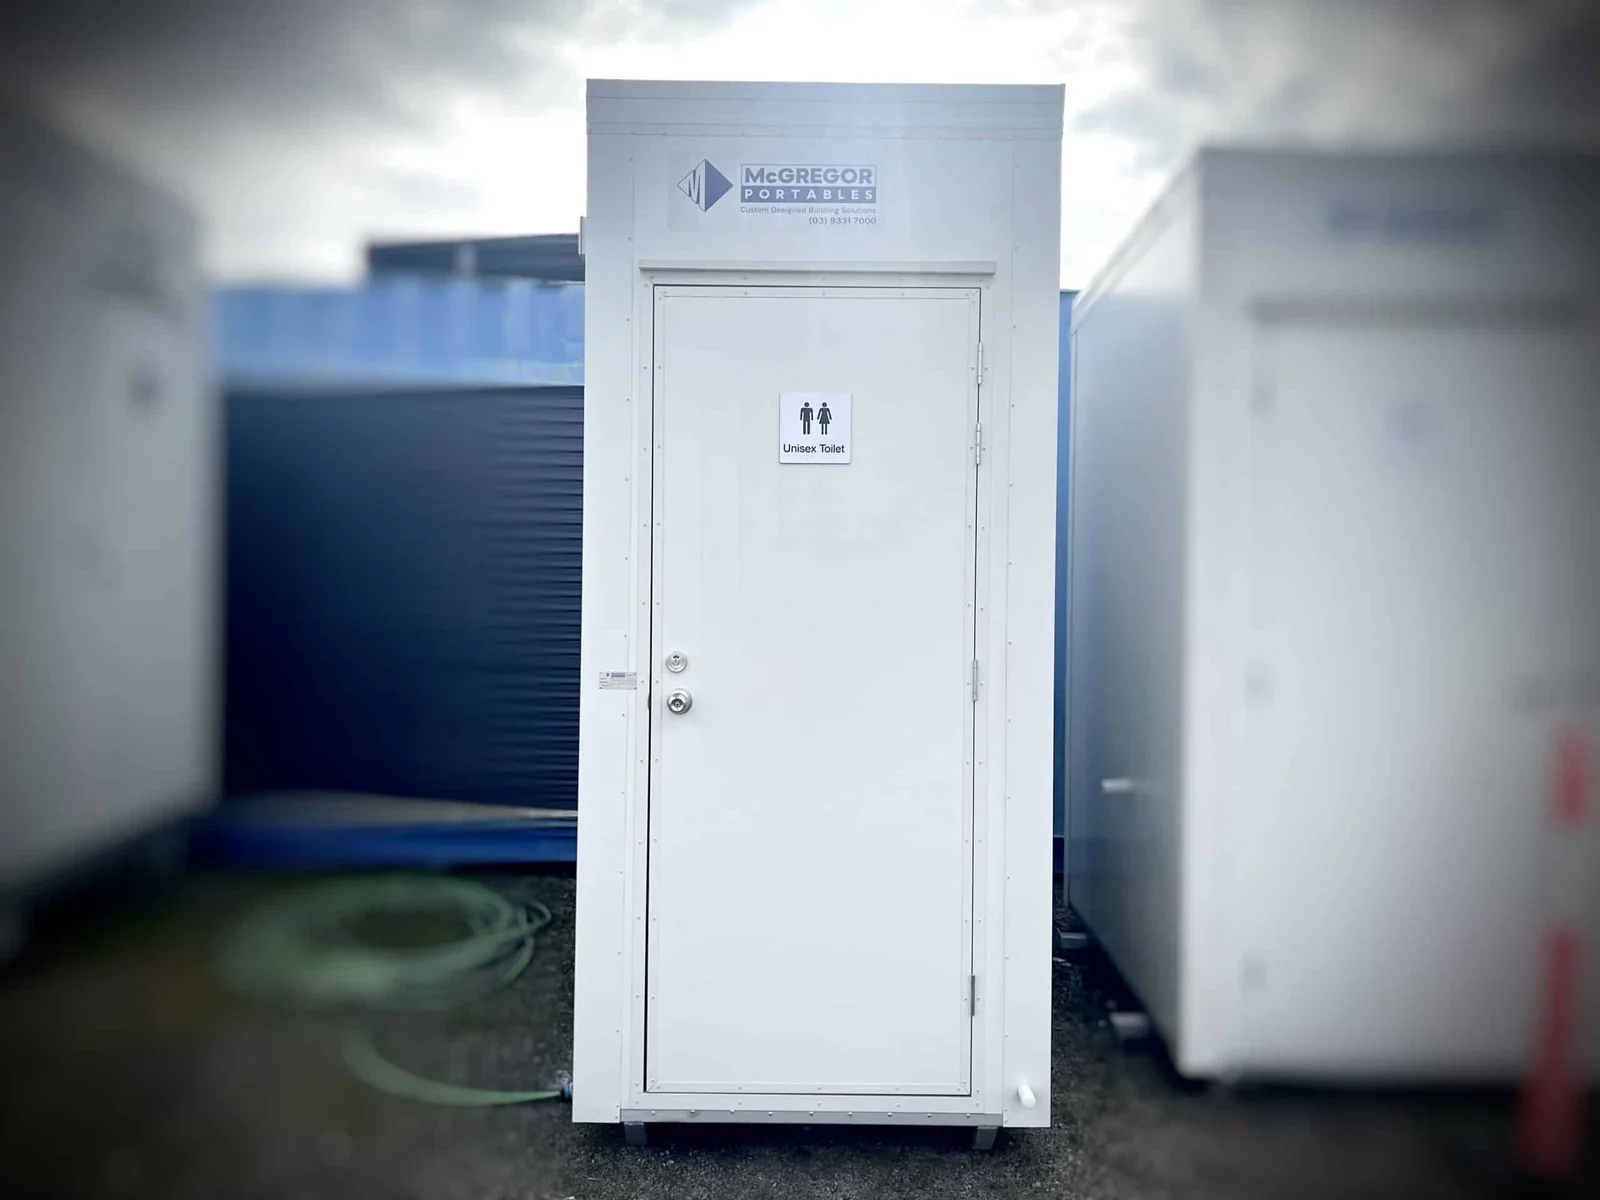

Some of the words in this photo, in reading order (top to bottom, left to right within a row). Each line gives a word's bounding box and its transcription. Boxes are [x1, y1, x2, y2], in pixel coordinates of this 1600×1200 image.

[745, 167, 873, 184] McGREGOR
[744, 188, 873, 200] PORTABLES
[740, 206, 769, 214] Custom
[771, 206, 806, 215] Designed
[808, 207, 840, 215] Building
[808, 217, 828, 226] (03)
[829, 217, 852, 225] 9331
[853, 217, 877, 225] 7000
[783, 443, 817, 453] Unisex
[819, 443, 845, 453] Toilet
